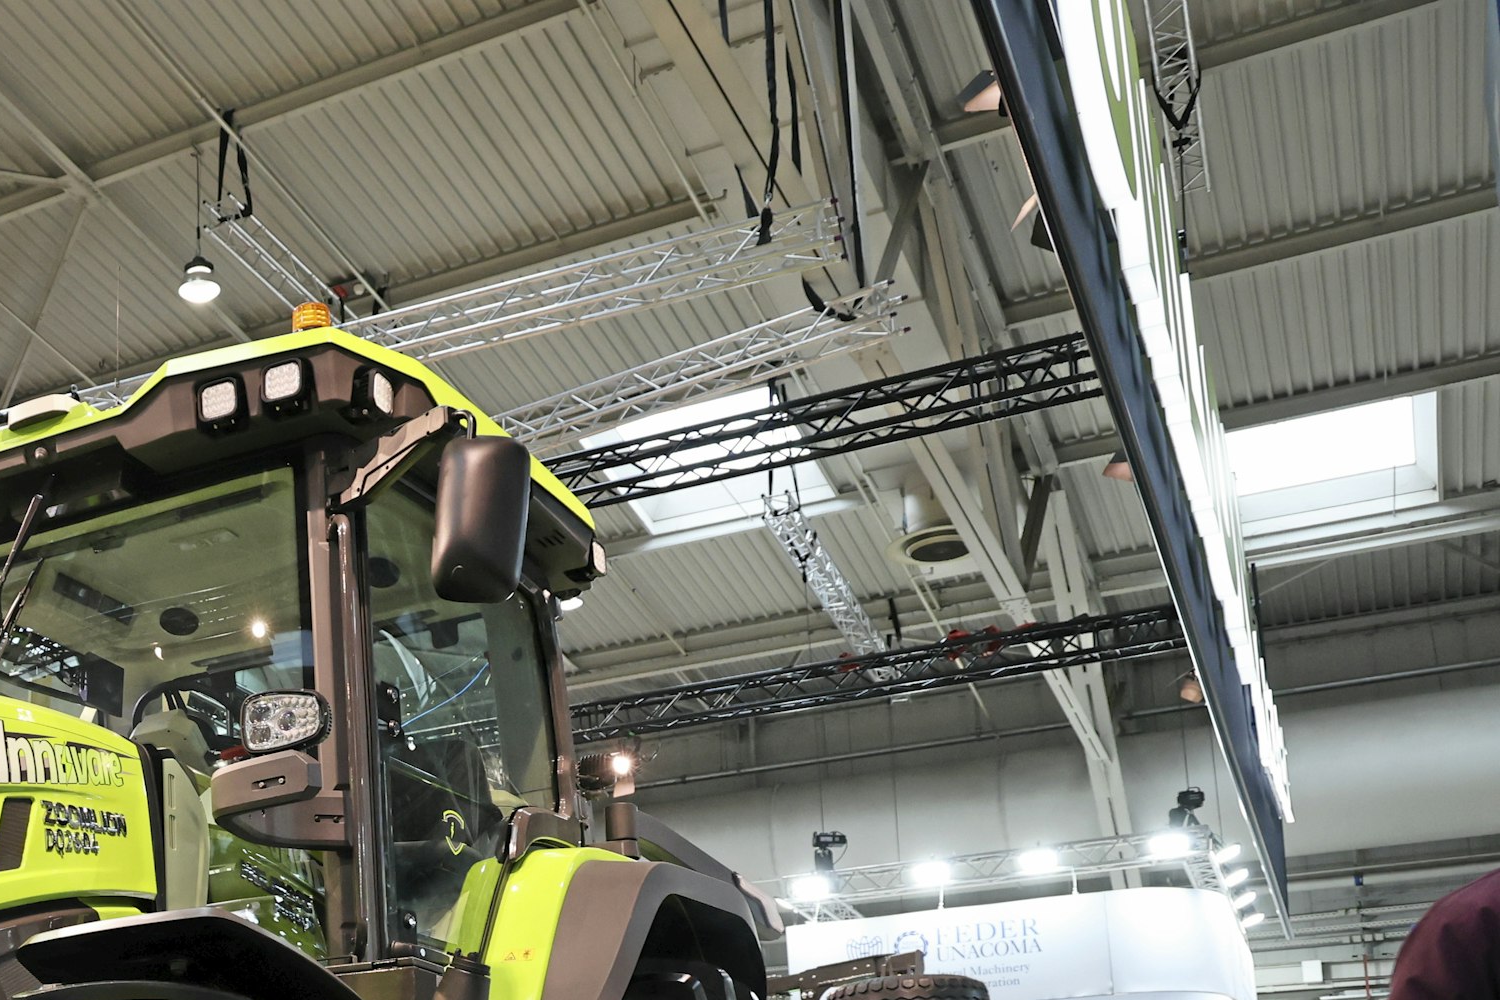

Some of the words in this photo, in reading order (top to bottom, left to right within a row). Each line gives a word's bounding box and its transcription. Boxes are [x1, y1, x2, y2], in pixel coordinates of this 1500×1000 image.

[41, 799, 127, 838] ZOOMLION
[936, 918, 1040, 945] FEDER
[936, 938, 1043, 962] UNACOMA
[971, 962, 1031, 977] Machinery
